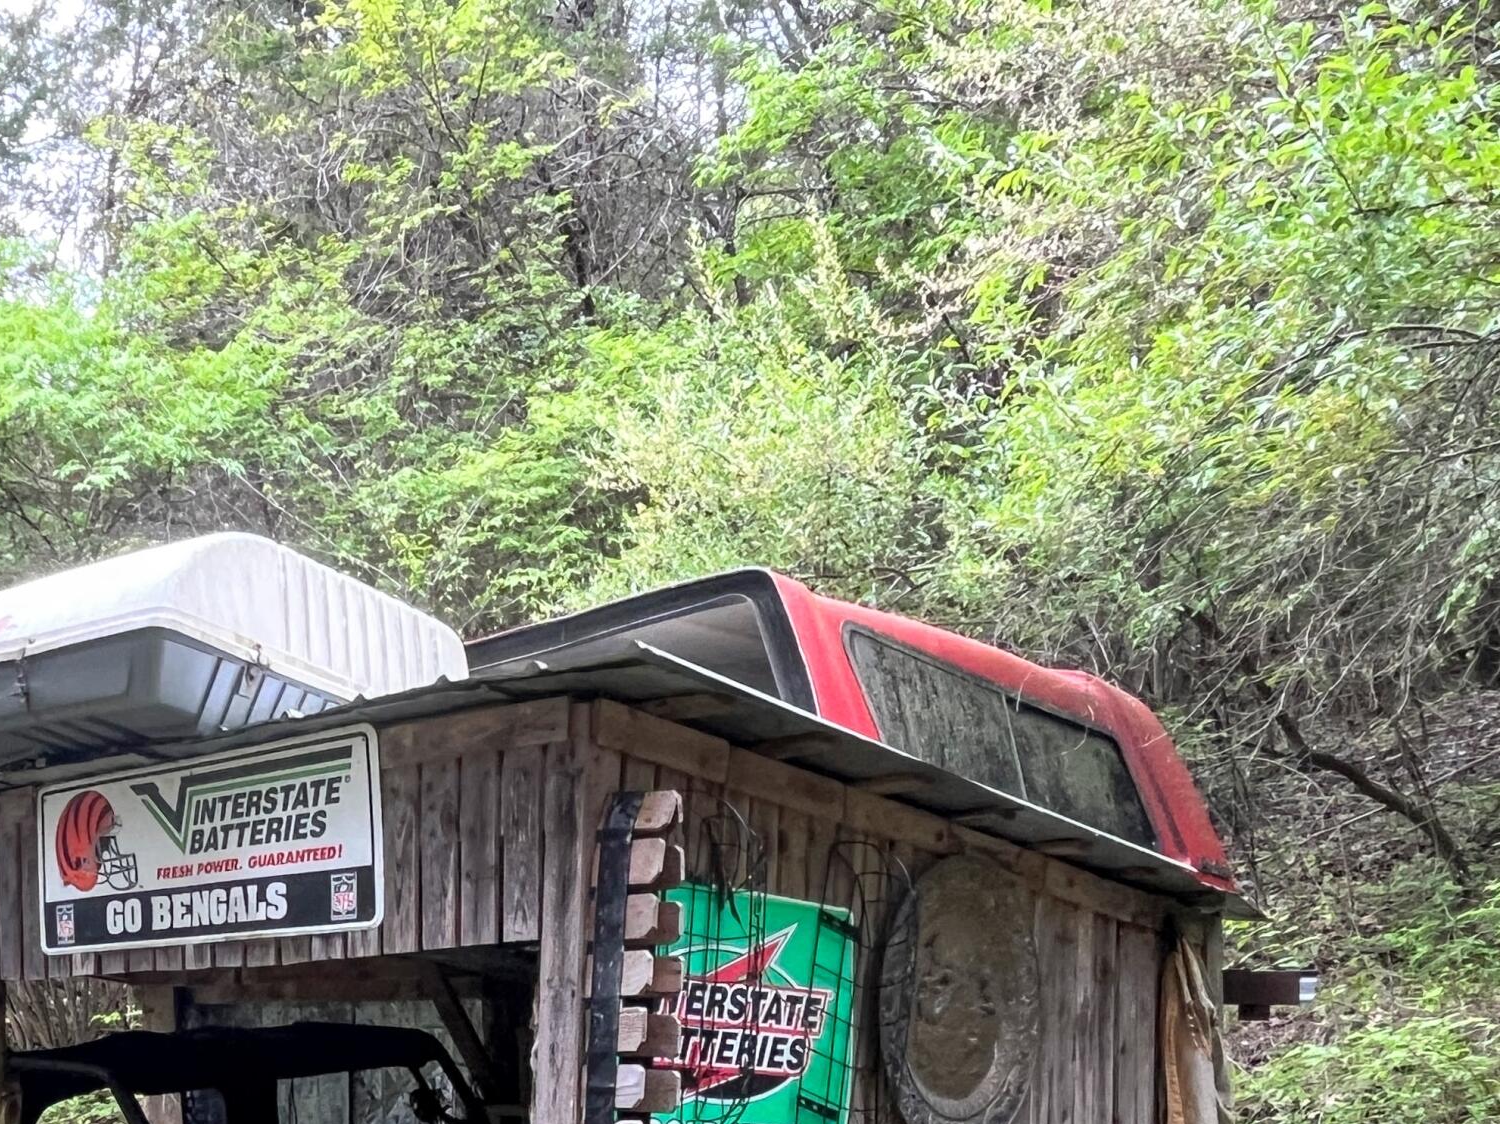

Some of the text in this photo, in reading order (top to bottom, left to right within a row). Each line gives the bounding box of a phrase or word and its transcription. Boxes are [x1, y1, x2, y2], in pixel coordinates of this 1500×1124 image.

[189, 810, 327, 855] BATTERIES
[156, 844, 343, 881] FRESH POWER. GUARANTEED!
[106, 898, 142, 935] GO
[151, 882, 288, 931] BENGALS
[667, 981, 824, 1033] ERSTATE
[678, 1026, 807, 1071] TTERIES
